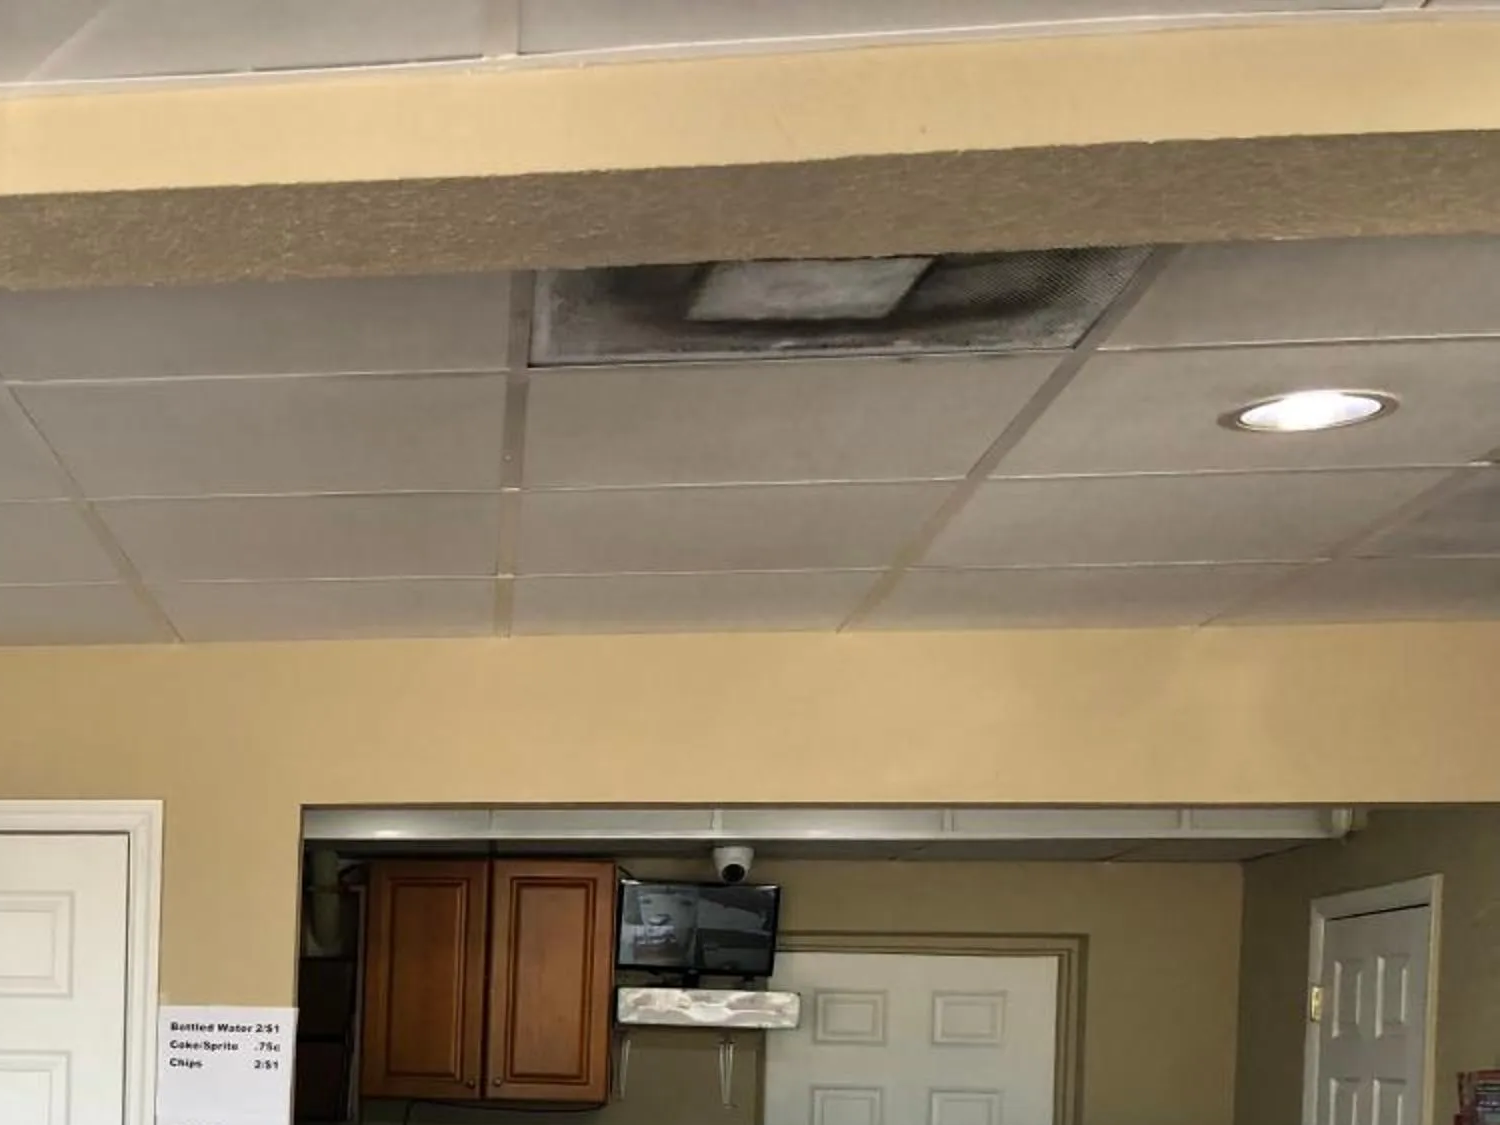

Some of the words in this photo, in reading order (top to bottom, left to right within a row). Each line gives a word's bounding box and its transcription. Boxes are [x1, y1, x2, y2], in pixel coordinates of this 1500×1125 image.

[171, 1021, 215, 1033] Bottled
[217, 1023, 251, 1033] Water
[169, 1058, 203, 1069] Chips
